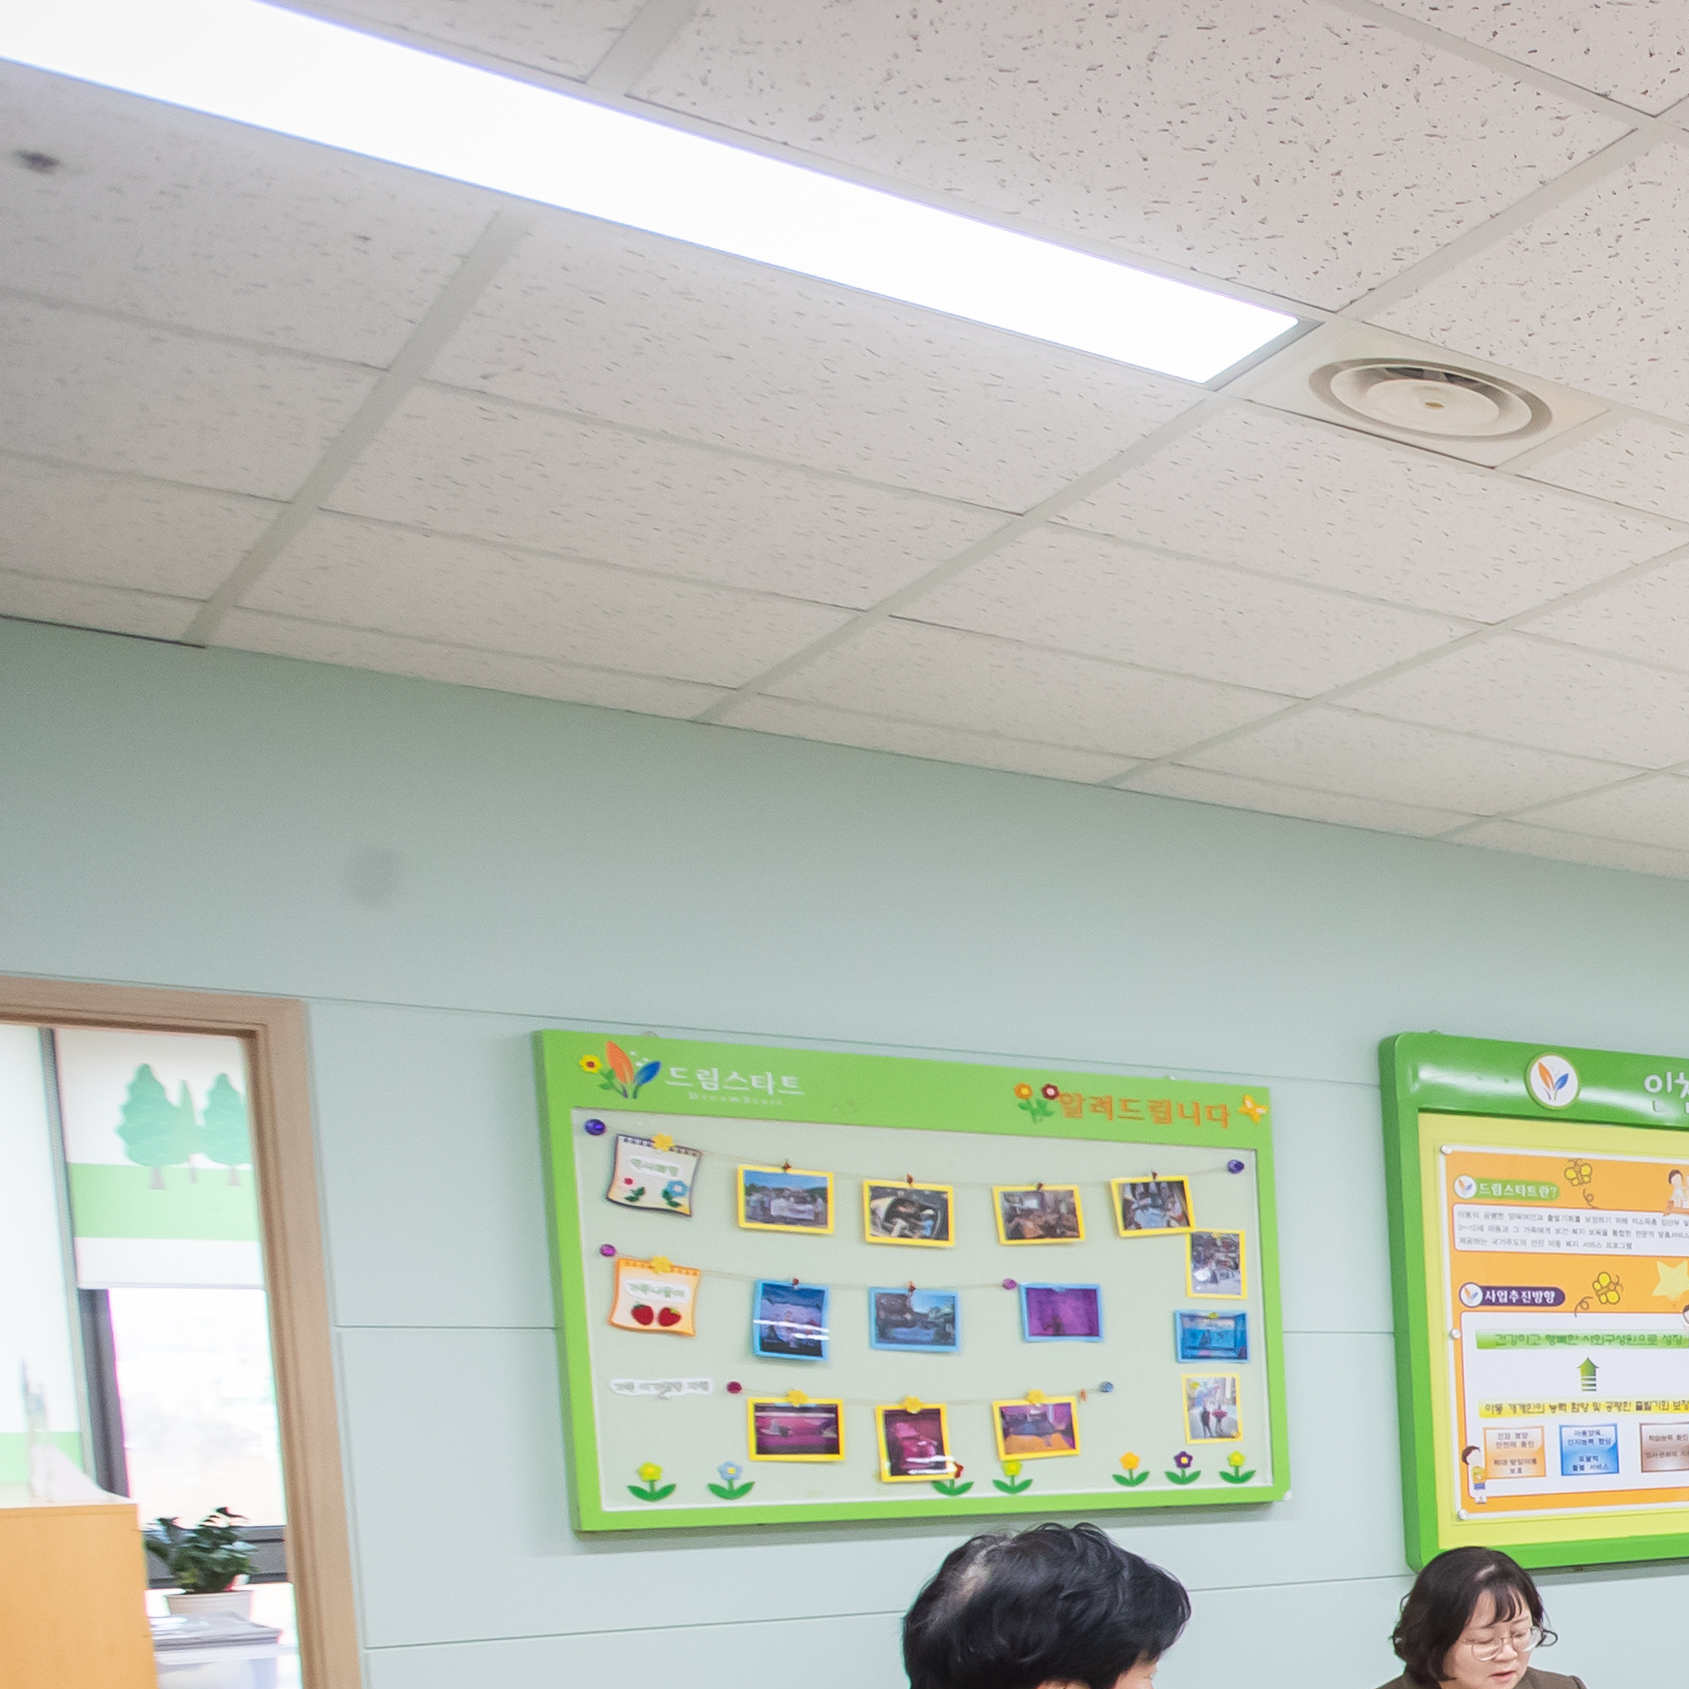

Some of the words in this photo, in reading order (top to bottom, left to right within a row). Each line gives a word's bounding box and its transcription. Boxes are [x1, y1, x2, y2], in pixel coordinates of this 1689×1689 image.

[665, 1067, 805, 1096] 드림스타트
[1056, 1092, 1231, 1129] 알려드립니다
[1479, 1182, 1558, 1199] 드림스타트란?
[1484, 1290, 1556, 1304] 사업추진방향
